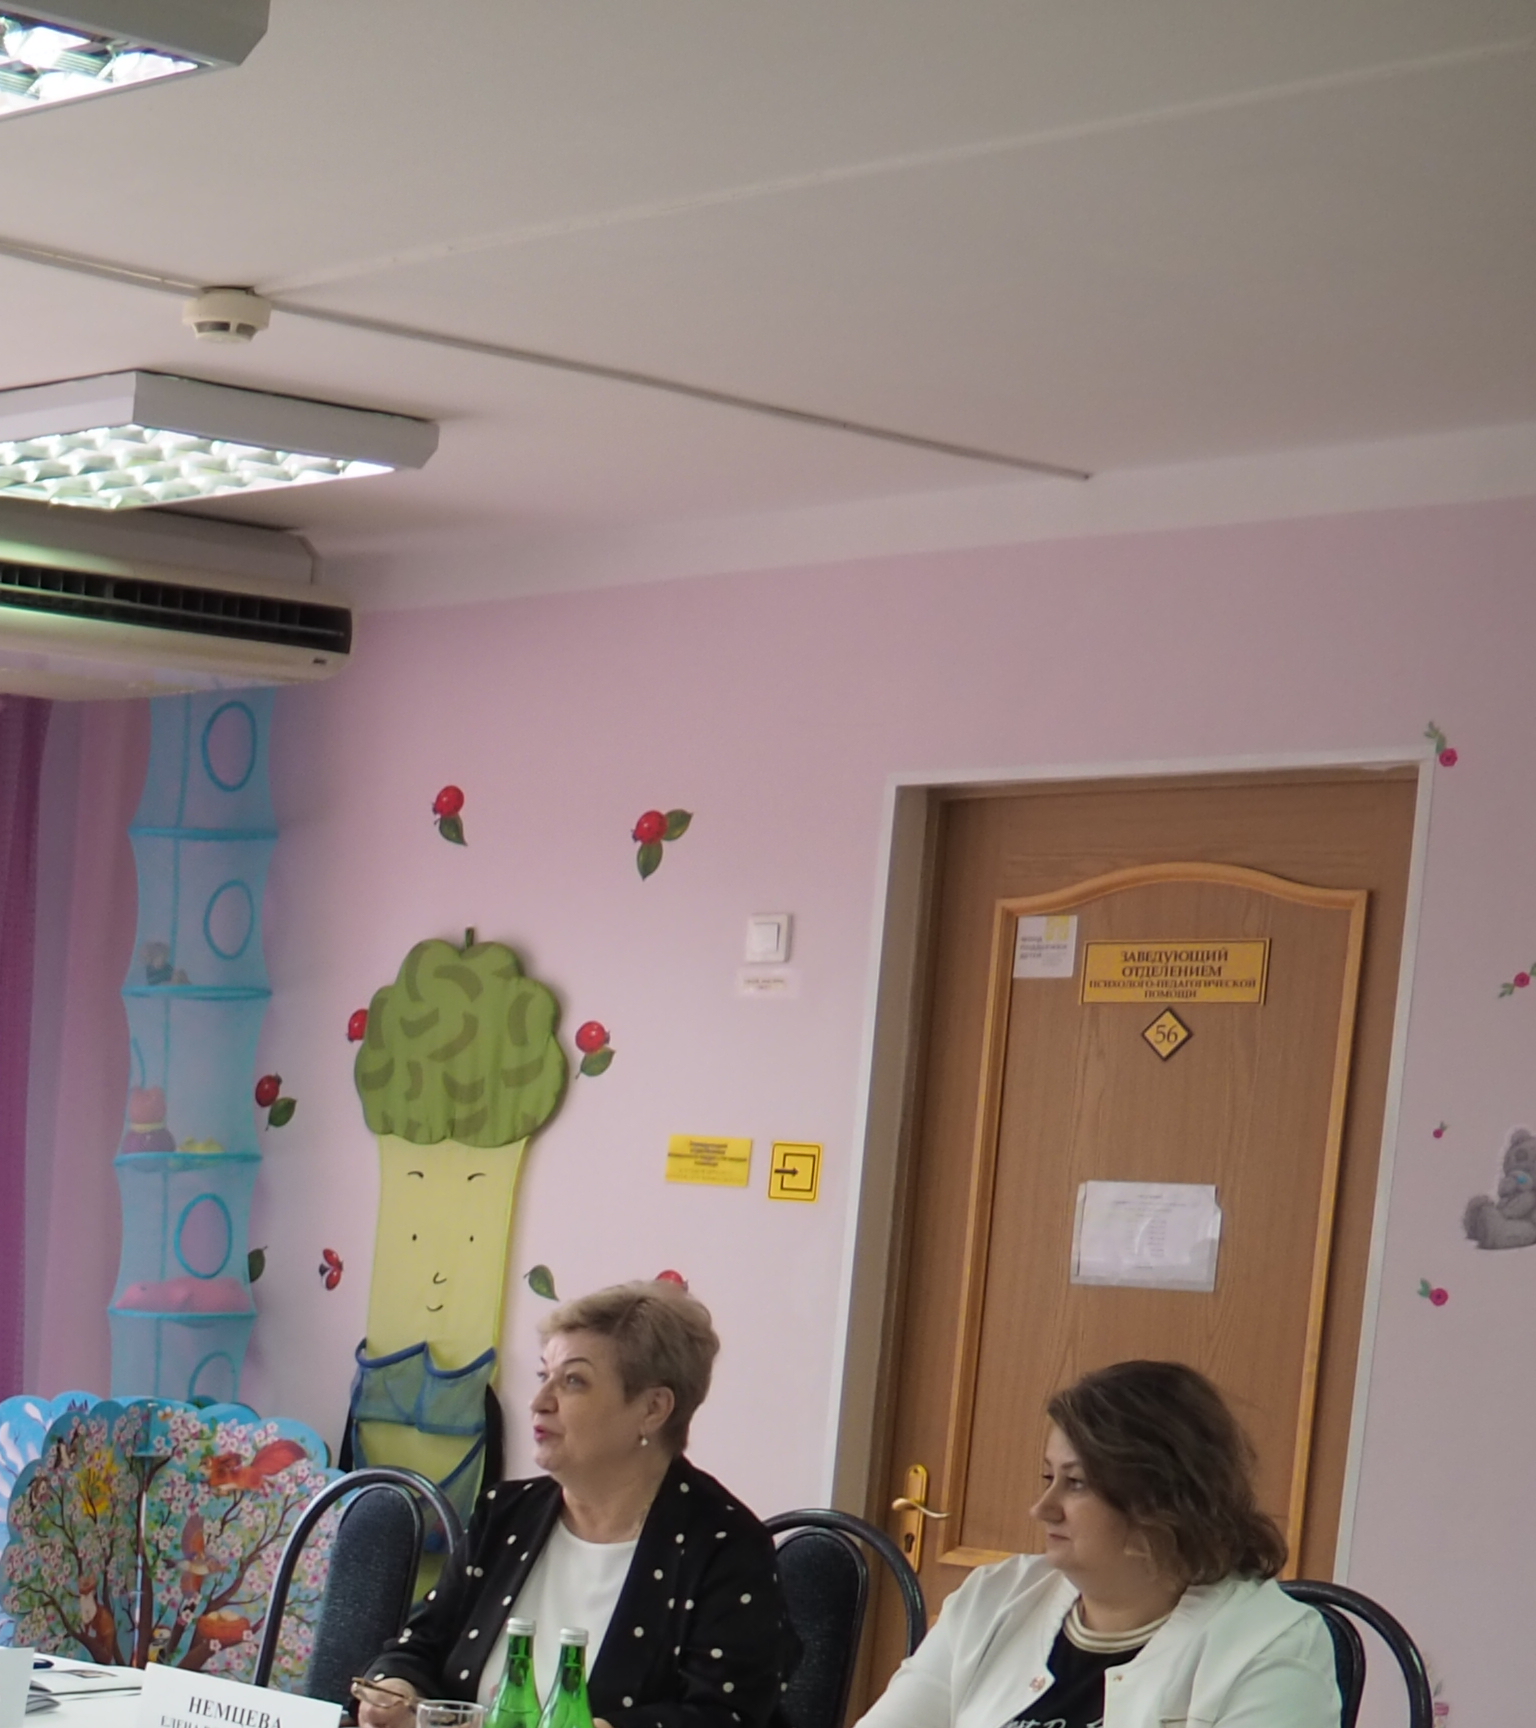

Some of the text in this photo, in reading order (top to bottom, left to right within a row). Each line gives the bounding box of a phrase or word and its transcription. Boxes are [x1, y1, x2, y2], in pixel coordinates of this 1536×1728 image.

[1121, 947, 1228, 964] ЗАВЕДУЮЩИЙ
[1122, 965, 1222, 978] ОТДЕЛЕНИЕМ
[1154, 1024, 1178, 1044] 56
